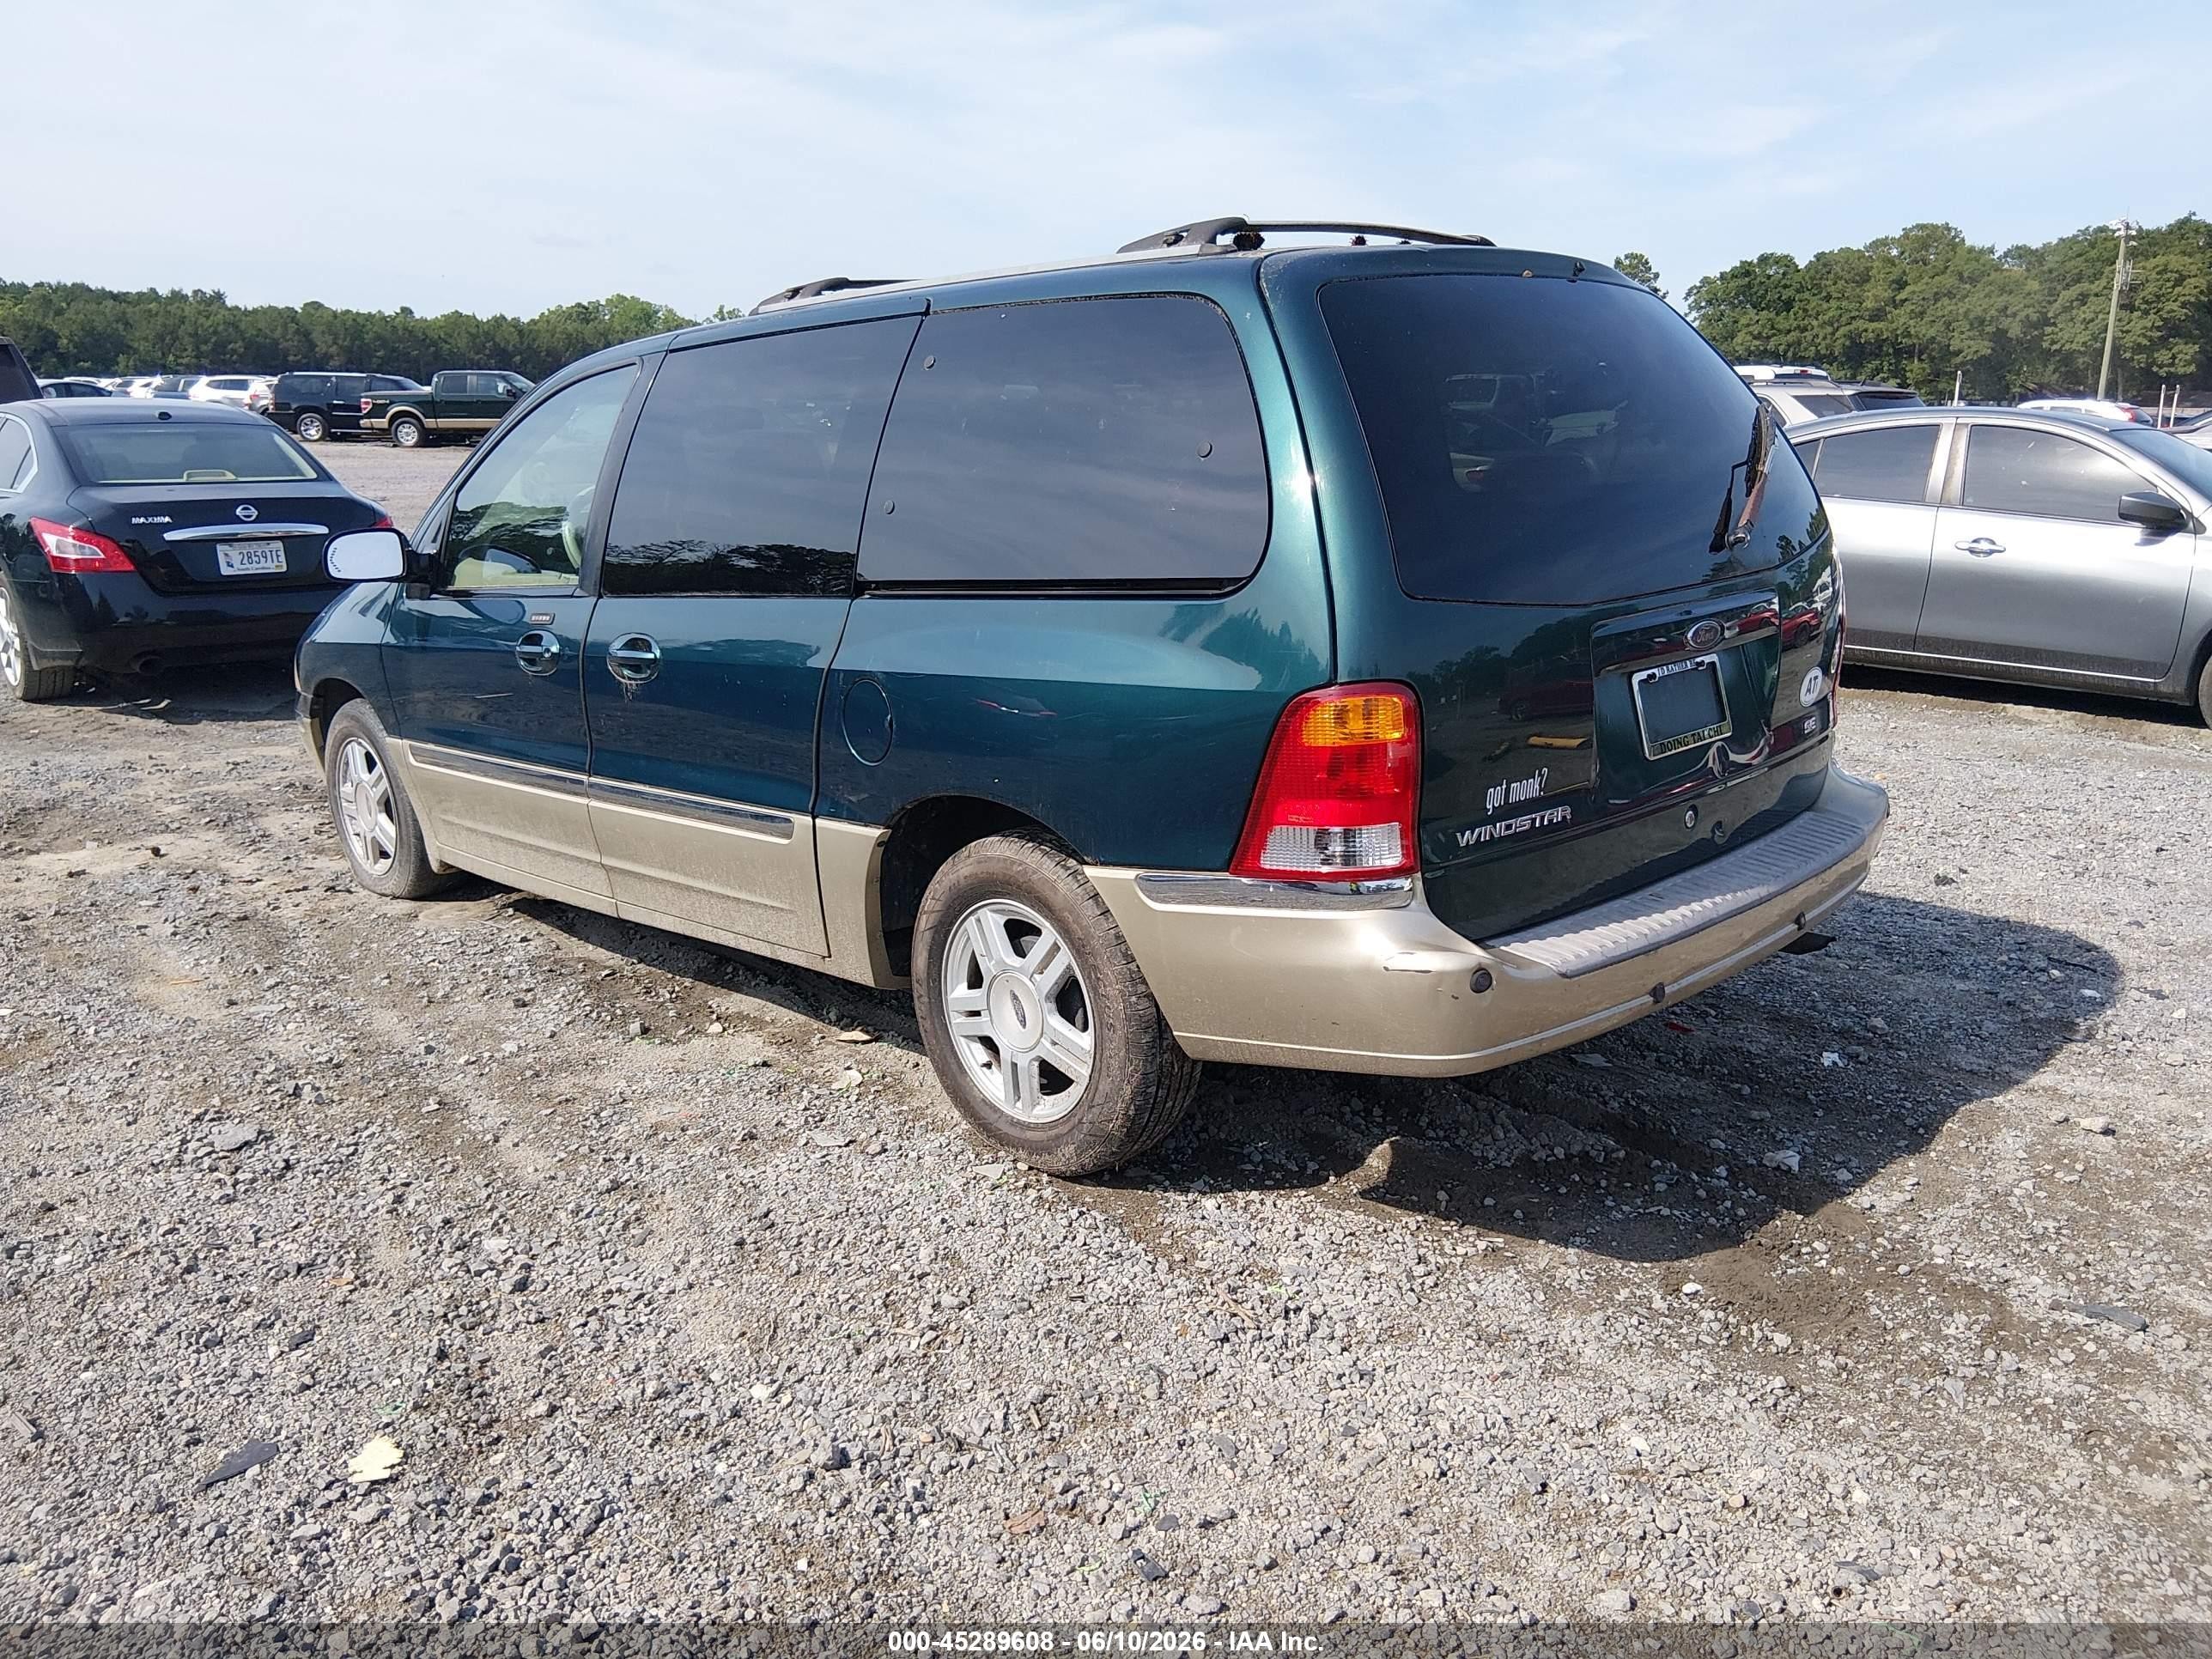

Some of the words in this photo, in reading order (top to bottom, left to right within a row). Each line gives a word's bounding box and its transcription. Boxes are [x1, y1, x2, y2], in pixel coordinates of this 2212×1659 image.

[131, 515, 173, 525] MAXIMA
[239, 550, 284, 566] 2859TE
[1660, 736, 1690, 754] DOING
[1690, 728, 1707, 744] TAI
[1707, 725, 1723, 738] CHI
[1486, 779, 1507, 816] got
[1509, 767, 1548, 804] monk?
[1455, 805, 1573, 848] WINDSTAR
